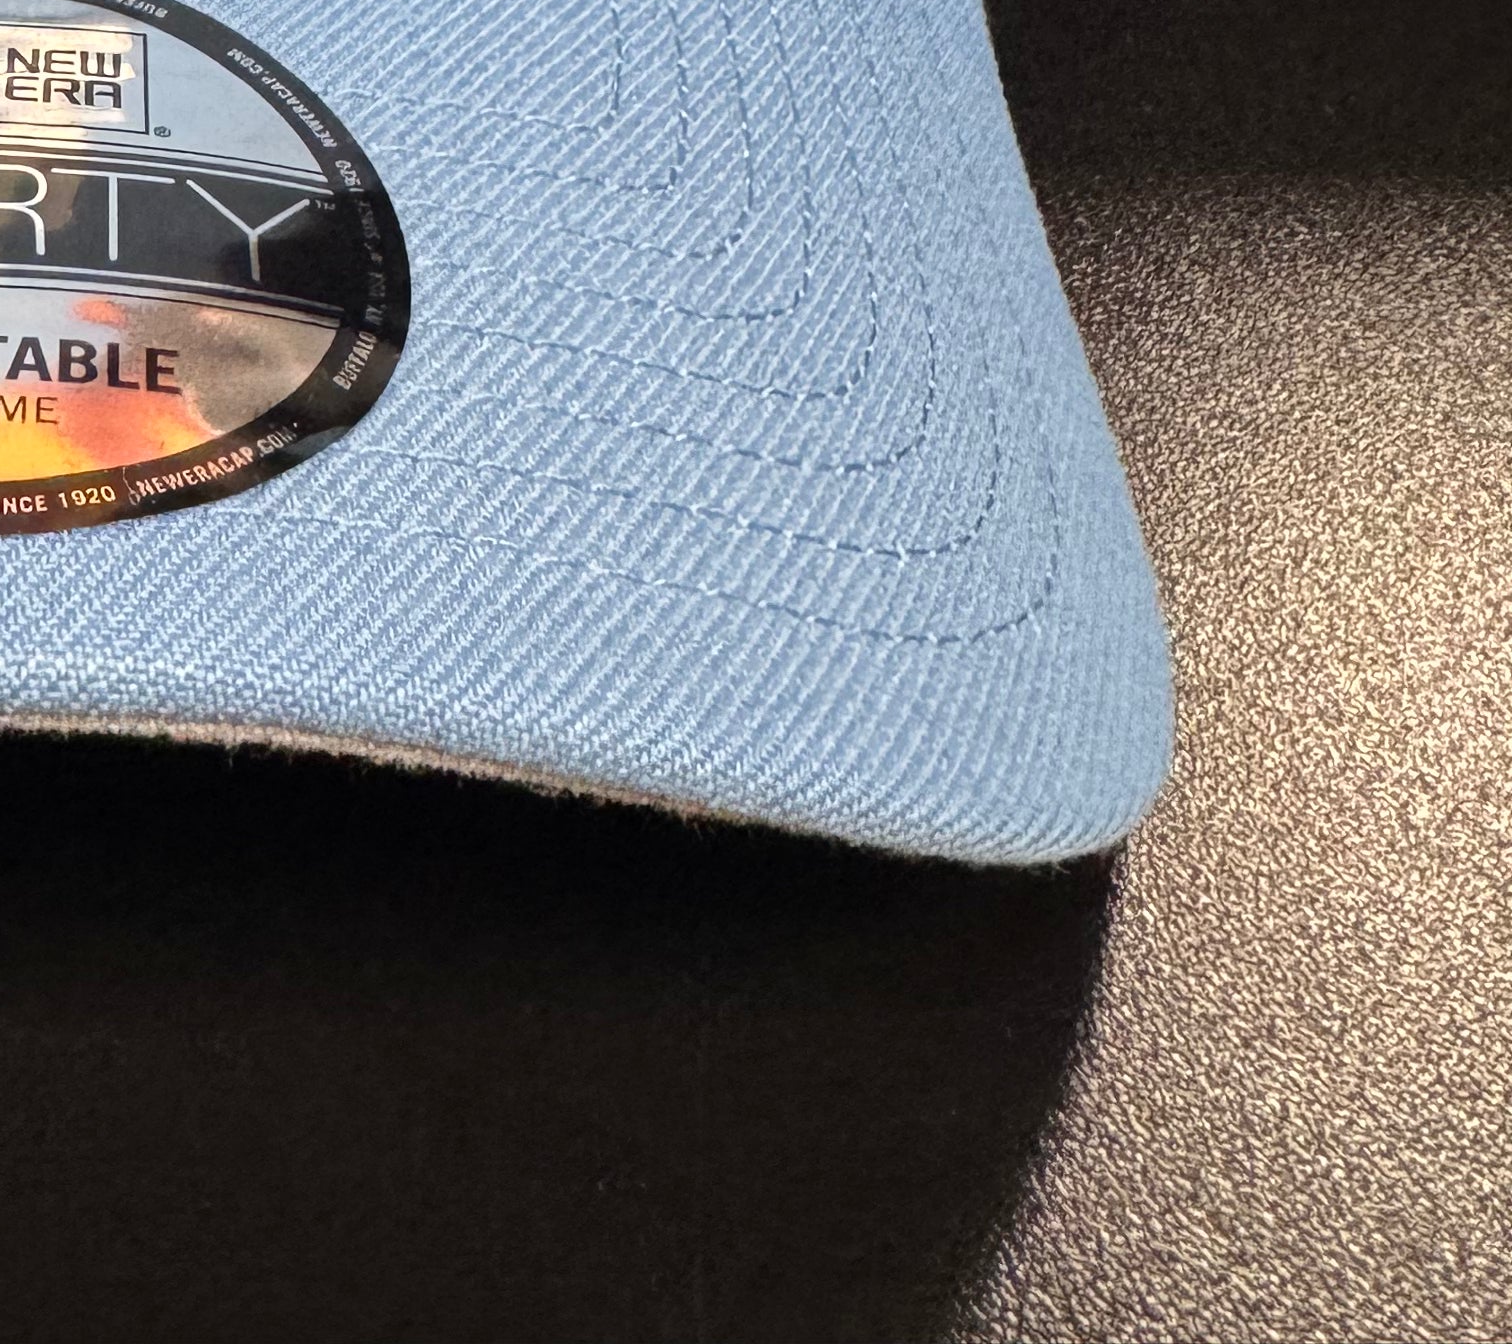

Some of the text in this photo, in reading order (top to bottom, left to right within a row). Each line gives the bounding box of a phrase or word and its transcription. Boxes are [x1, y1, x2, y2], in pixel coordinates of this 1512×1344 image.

[5, 47, 122, 78] NEW
[3, 75, 122, 109] ERA
[58, 485, 116, 509] 1920
